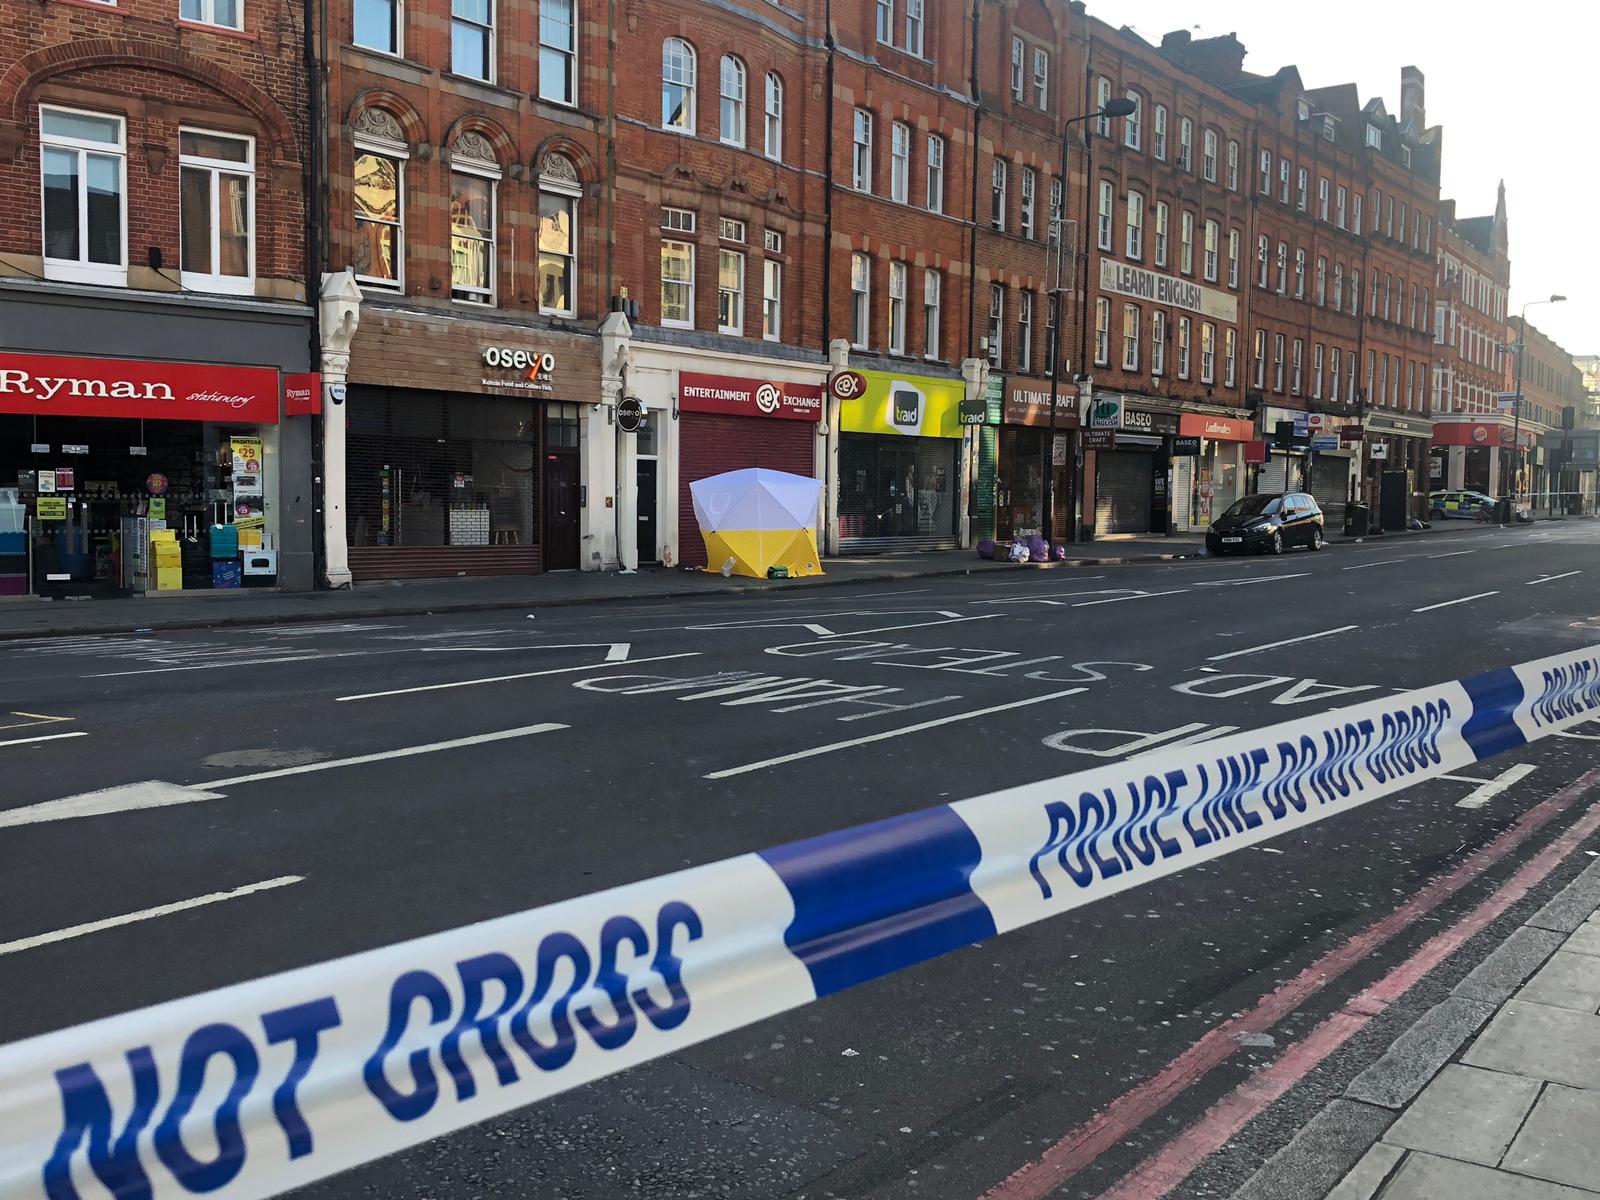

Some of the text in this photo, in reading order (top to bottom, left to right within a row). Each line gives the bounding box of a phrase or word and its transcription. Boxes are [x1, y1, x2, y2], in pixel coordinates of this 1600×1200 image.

[1116, 264, 1155, 299] LEARN
[1157, 276, 1201, 311] ENGLISH
[486, 347, 555, 380] oseyo
[0, 369, 176, 401] Ryman
[286, 388, 311, 399] Ryman
[684, 386, 751, 402] ENTERTAINMENT
[185, 390, 256, 409] stationery
[783, 395, 820, 408] EXCHANGE
[1013, 389, 1051, 406] ULTIMATE
[896, 406, 917, 423] traid
[960, 411, 985, 424] traid
[1125, 411, 1152, 427] BASEO
[1530, 659, 1592, 727] POLICE
[1029, 768, 1190, 899] POLICE
[1181, 747, 1274, 848] LINE
[1262, 733, 1315, 821] DO
[1310, 717, 1376, 803] NOT
[1366, 697, 1452, 784] CROSS
[43, 901, 703, 1200] NOT CROSS
